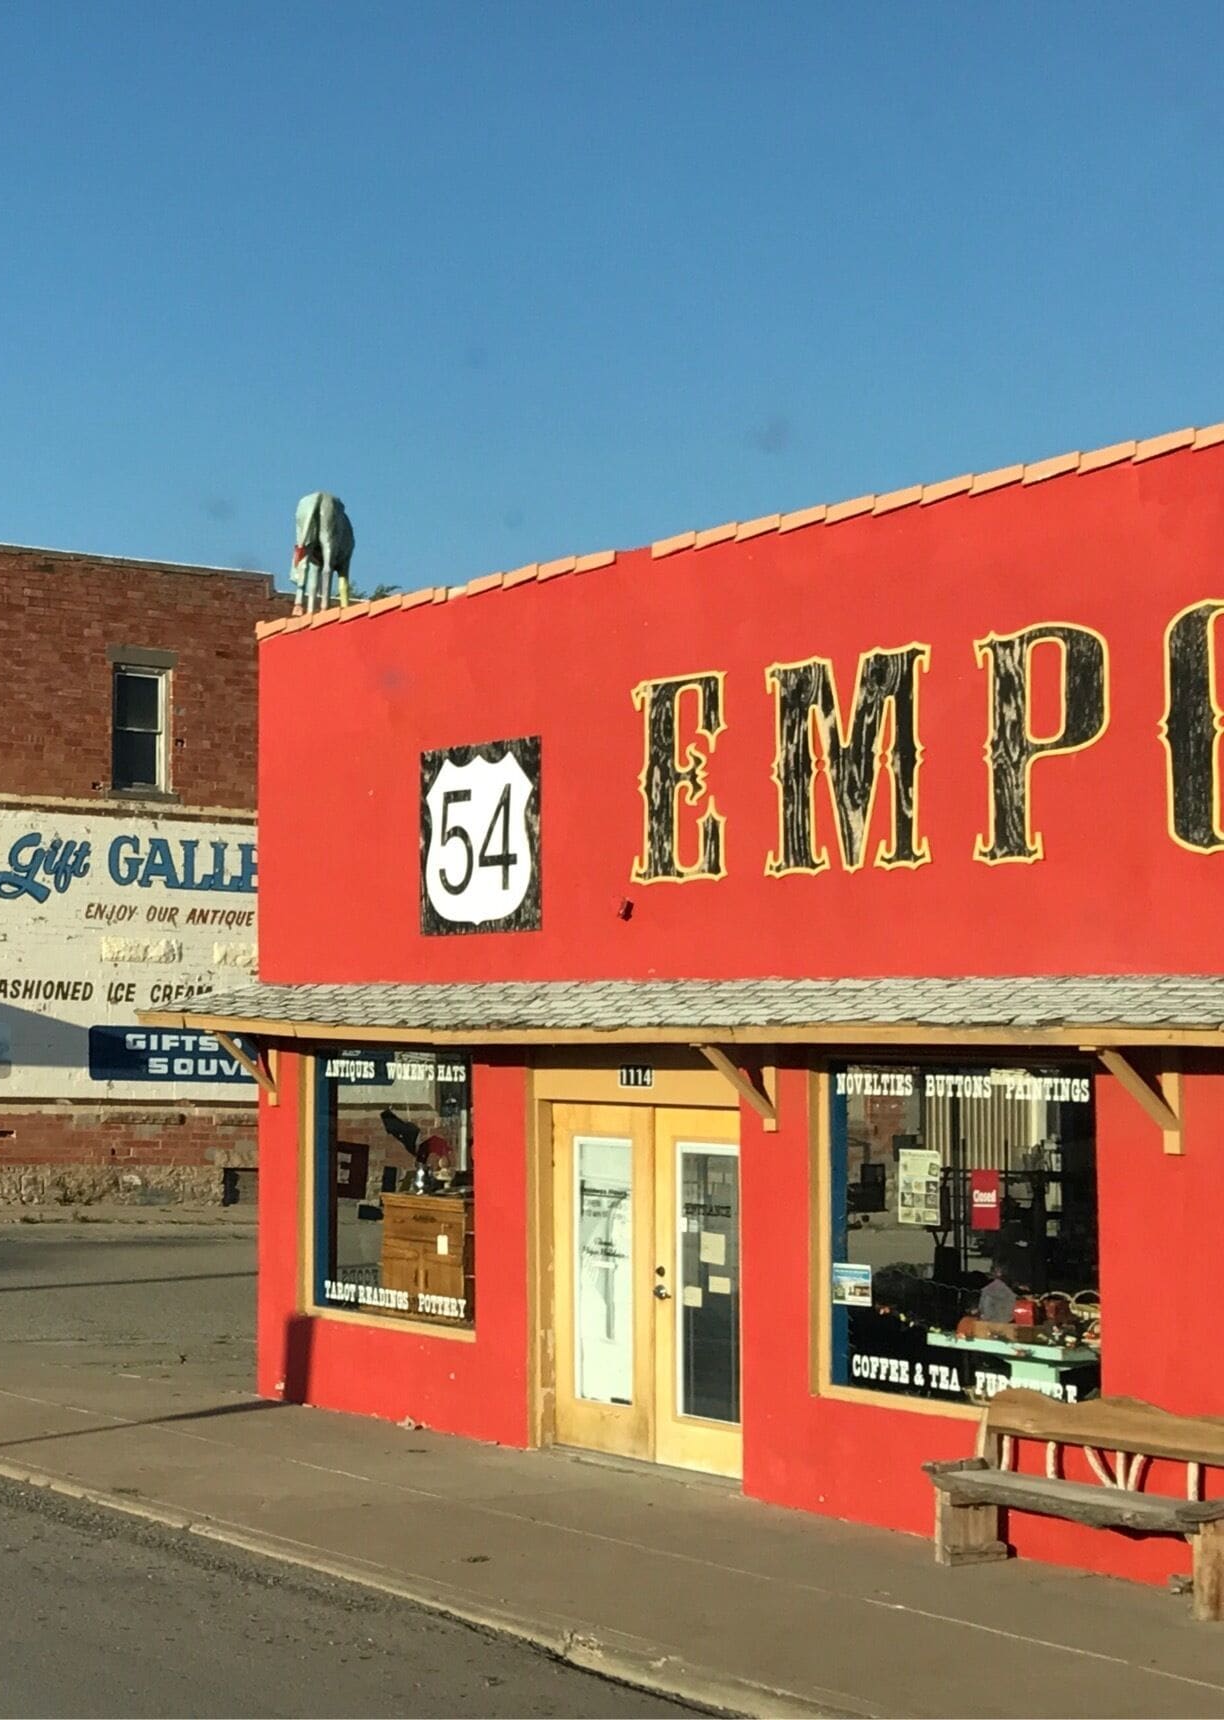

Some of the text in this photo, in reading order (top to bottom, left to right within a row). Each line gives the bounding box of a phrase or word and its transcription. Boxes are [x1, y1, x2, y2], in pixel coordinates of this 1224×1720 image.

[437, 782, 518, 897] 54
[85, 903, 254, 929] ENJOY OUR ANTIQUE
[107, 982, 137, 1004] ICE
[126, 1033, 219, 1053] GIFTS
[325, 1059, 466, 1082] ANTIQUES WOMEN'S HATS
[621, 1068, 651, 1086] 1114
[836, 1073, 1090, 1102] NOVELTIES BUTTONS PAINTINGS
[973, 1189, 997, 1203] Closed
[324, 1280, 467, 1318] TAROT READINGS POTTERY
[852, 1354, 910, 1385] COFFEE
[914, 1362, 925, 1386] &
[929, 1363, 960, 1391] TEA
